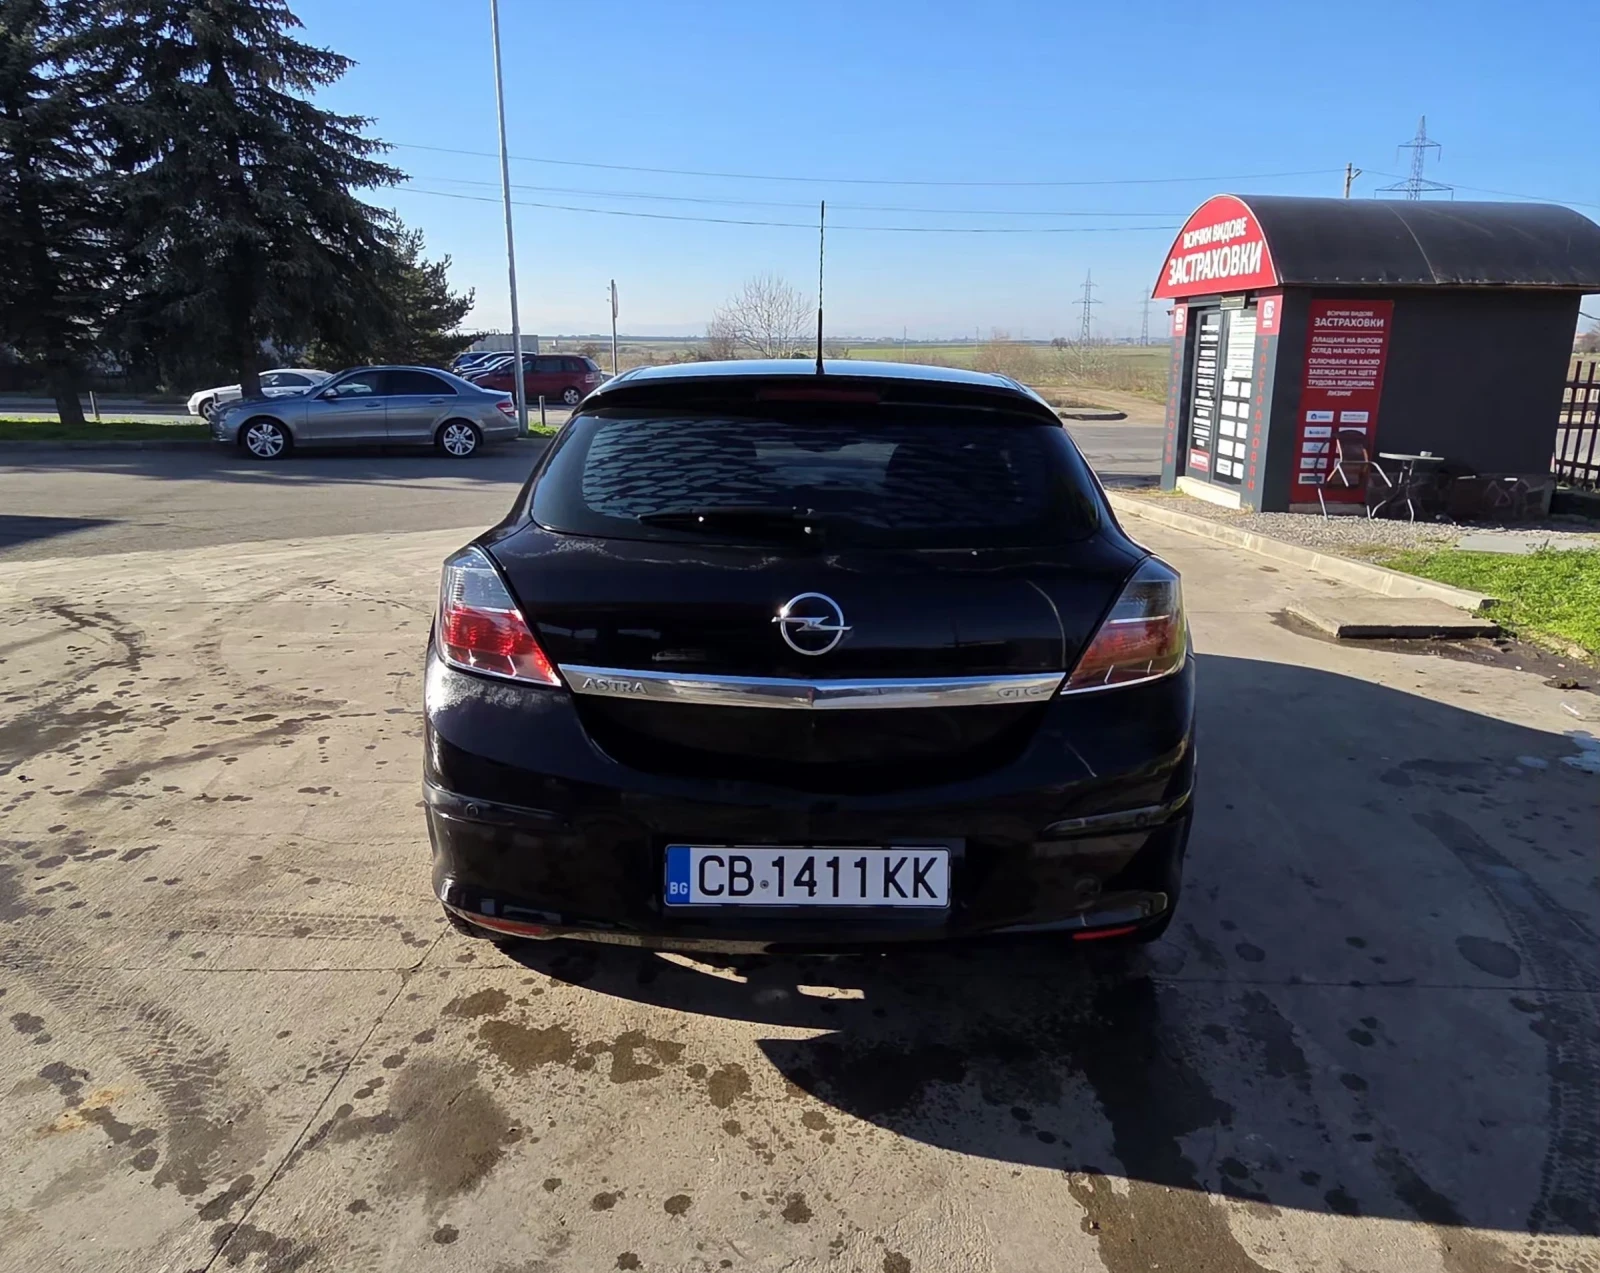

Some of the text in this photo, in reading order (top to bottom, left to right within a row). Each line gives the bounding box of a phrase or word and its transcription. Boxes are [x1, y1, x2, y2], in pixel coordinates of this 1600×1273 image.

[1212, 217, 1248, 244] ВИДОВЕ
[1168, 240, 1263, 286] ЗАСТРАХОВКИ
[1314, 317, 1384, 327] ЗАСТРАХОВКИ
[582, 678, 648, 694] ASTRA
[670, 882, 688, 895] BG
